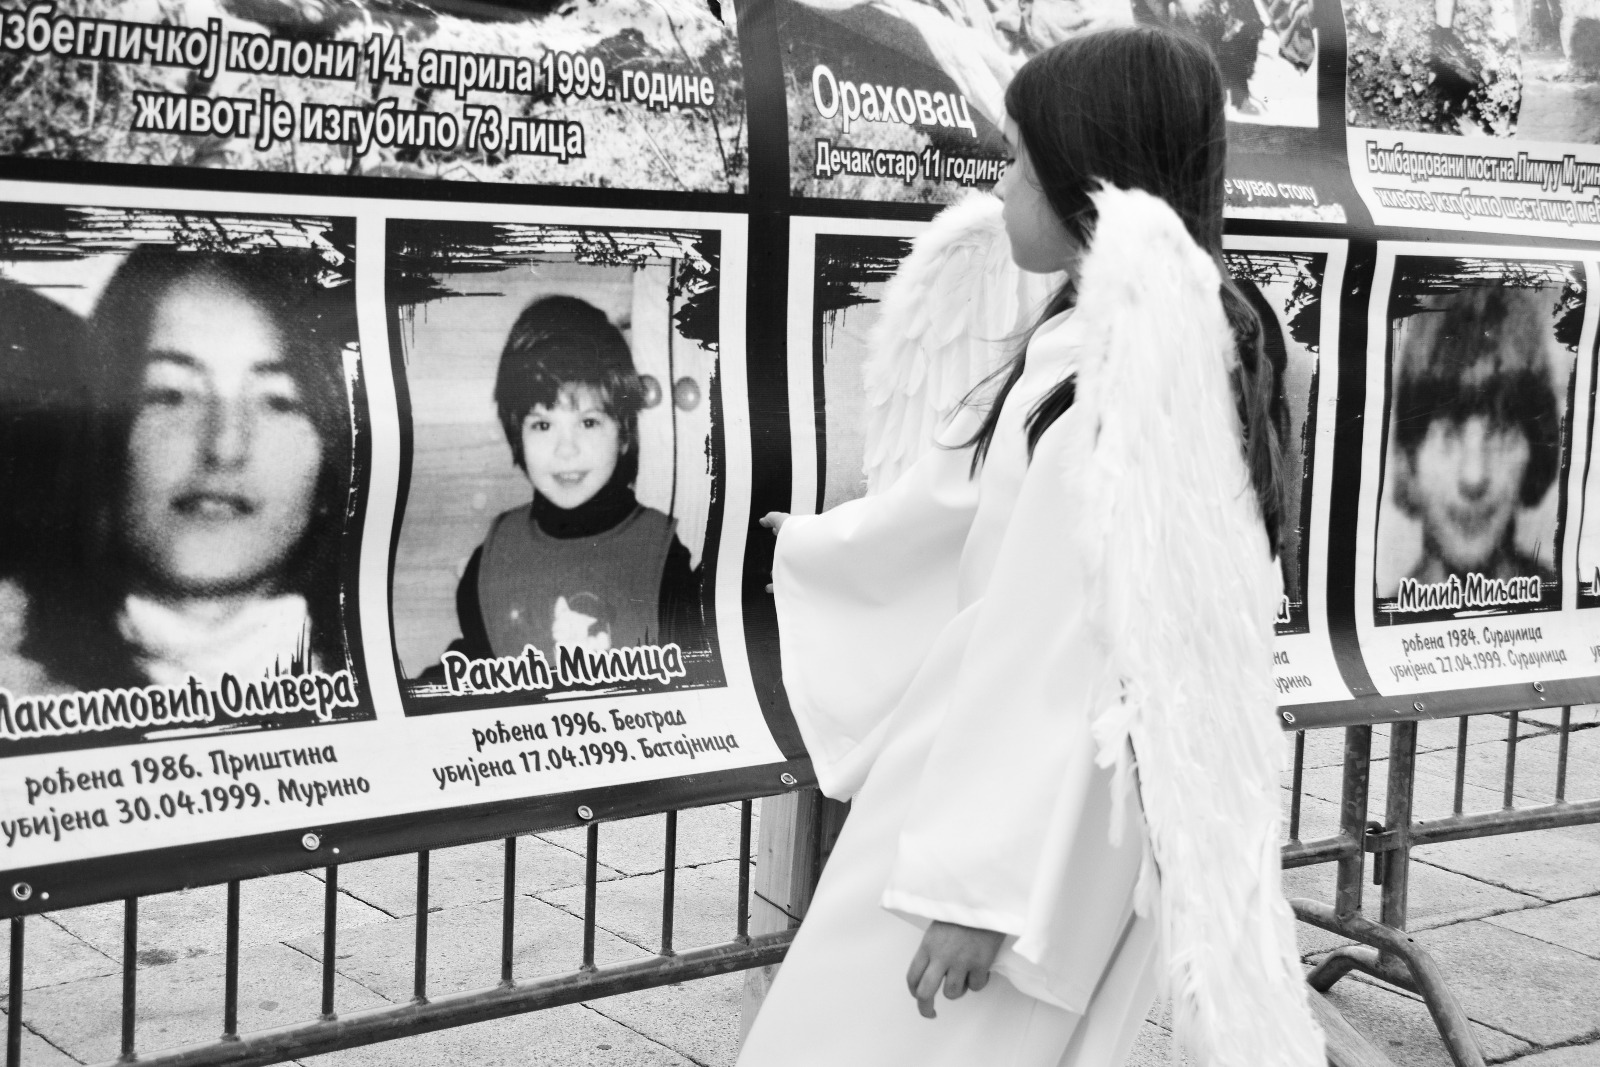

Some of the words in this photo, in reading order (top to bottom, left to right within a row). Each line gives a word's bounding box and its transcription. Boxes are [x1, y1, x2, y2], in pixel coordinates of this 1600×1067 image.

[230, 32, 356, 77] колони
[367, 35, 410, 82] 14.
[421, 51, 532, 96] априла
[543, 53, 613, 97] 1999.
[623, 69, 715, 107] године
[812, 64, 977, 137] Ораховац
[137, 94, 252, 135] живот
[260, 90, 292, 148] је
[304, 101, 456, 153] изгубило
[465, 108, 499, 150] 73
[509, 122, 583, 160] лица
[816, 142, 871, 176] Дечак
[876, 152, 916, 182] стар
[923, 150, 941, 177] 11
[1366, 140, 1464, 183] Бомбардовани
[1466, 156, 1497, 181] мост
[1499, 159, 1515, 182] на
[1517, 153, 1550, 191] Лиму
[1232, 179, 1278, 202] чувао
[1277, 183, 1319, 207] стоку
[1373, 187, 1434, 212] животе
[1430, 187, 1502, 220] изгубило
[1501, 197, 1539, 220] шест
[1540, 199, 1576, 227] лица
[1400, 576, 1461, 610] Милић
[1466, 573, 1539, 606] Миљана
[1402, 633, 1445, 657] рођена
[1447, 628, 1480, 647] 1984.
[1482, 626, 1543, 648] Сурдулица
[446, 648, 549, 691] Ракић
[560, 645, 682, 683] Милица
[1275, 674, 1312, 694] урино
[1390, 659, 1436, 682] убијена
[1436, 651, 1506, 673] 27.04.1999.
[1507, 649, 1567, 670] Сурдулица
[221, 673, 354, 719] Оливера
[473, 720, 547, 751] рођена
[552, 711, 606, 736] 1996.
[609, 709, 686, 733] Београд
[25, 766, 124, 804] рођена
[131, 754, 203, 784] 1986.
[209, 744, 338, 779] Приштина
[433, 754, 516, 790] убијена
[519, 740, 636, 773] 17.04.1999.
[637, 733, 739, 760] Батајница
[1, 805, 109, 847] убијена
[116, 782, 270, 825] 30.04.1999.
[278, 776, 371, 806] Мурино
